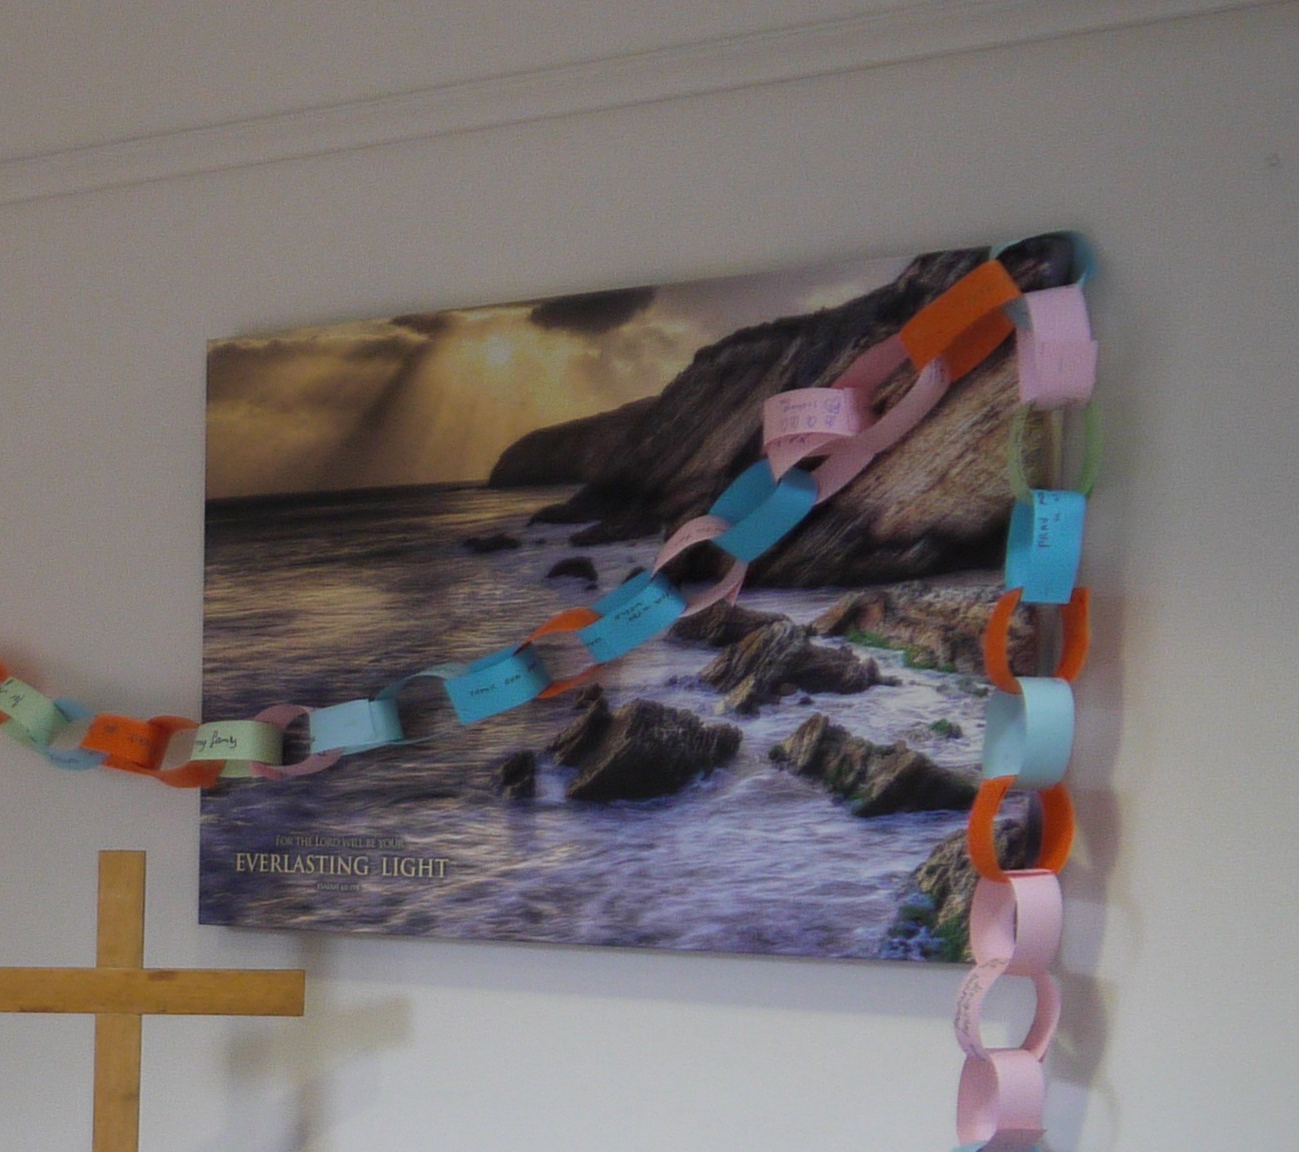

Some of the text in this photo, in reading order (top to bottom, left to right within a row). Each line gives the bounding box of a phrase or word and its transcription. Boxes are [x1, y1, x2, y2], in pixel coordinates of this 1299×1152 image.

[295, 836, 313, 847] THE
[315, 836, 342, 848] LORD
[366, 838, 377, 848] BE
[378, 838, 405, 849] YOUR
[235, 852, 450, 878] EVERLASTING LIGHT
